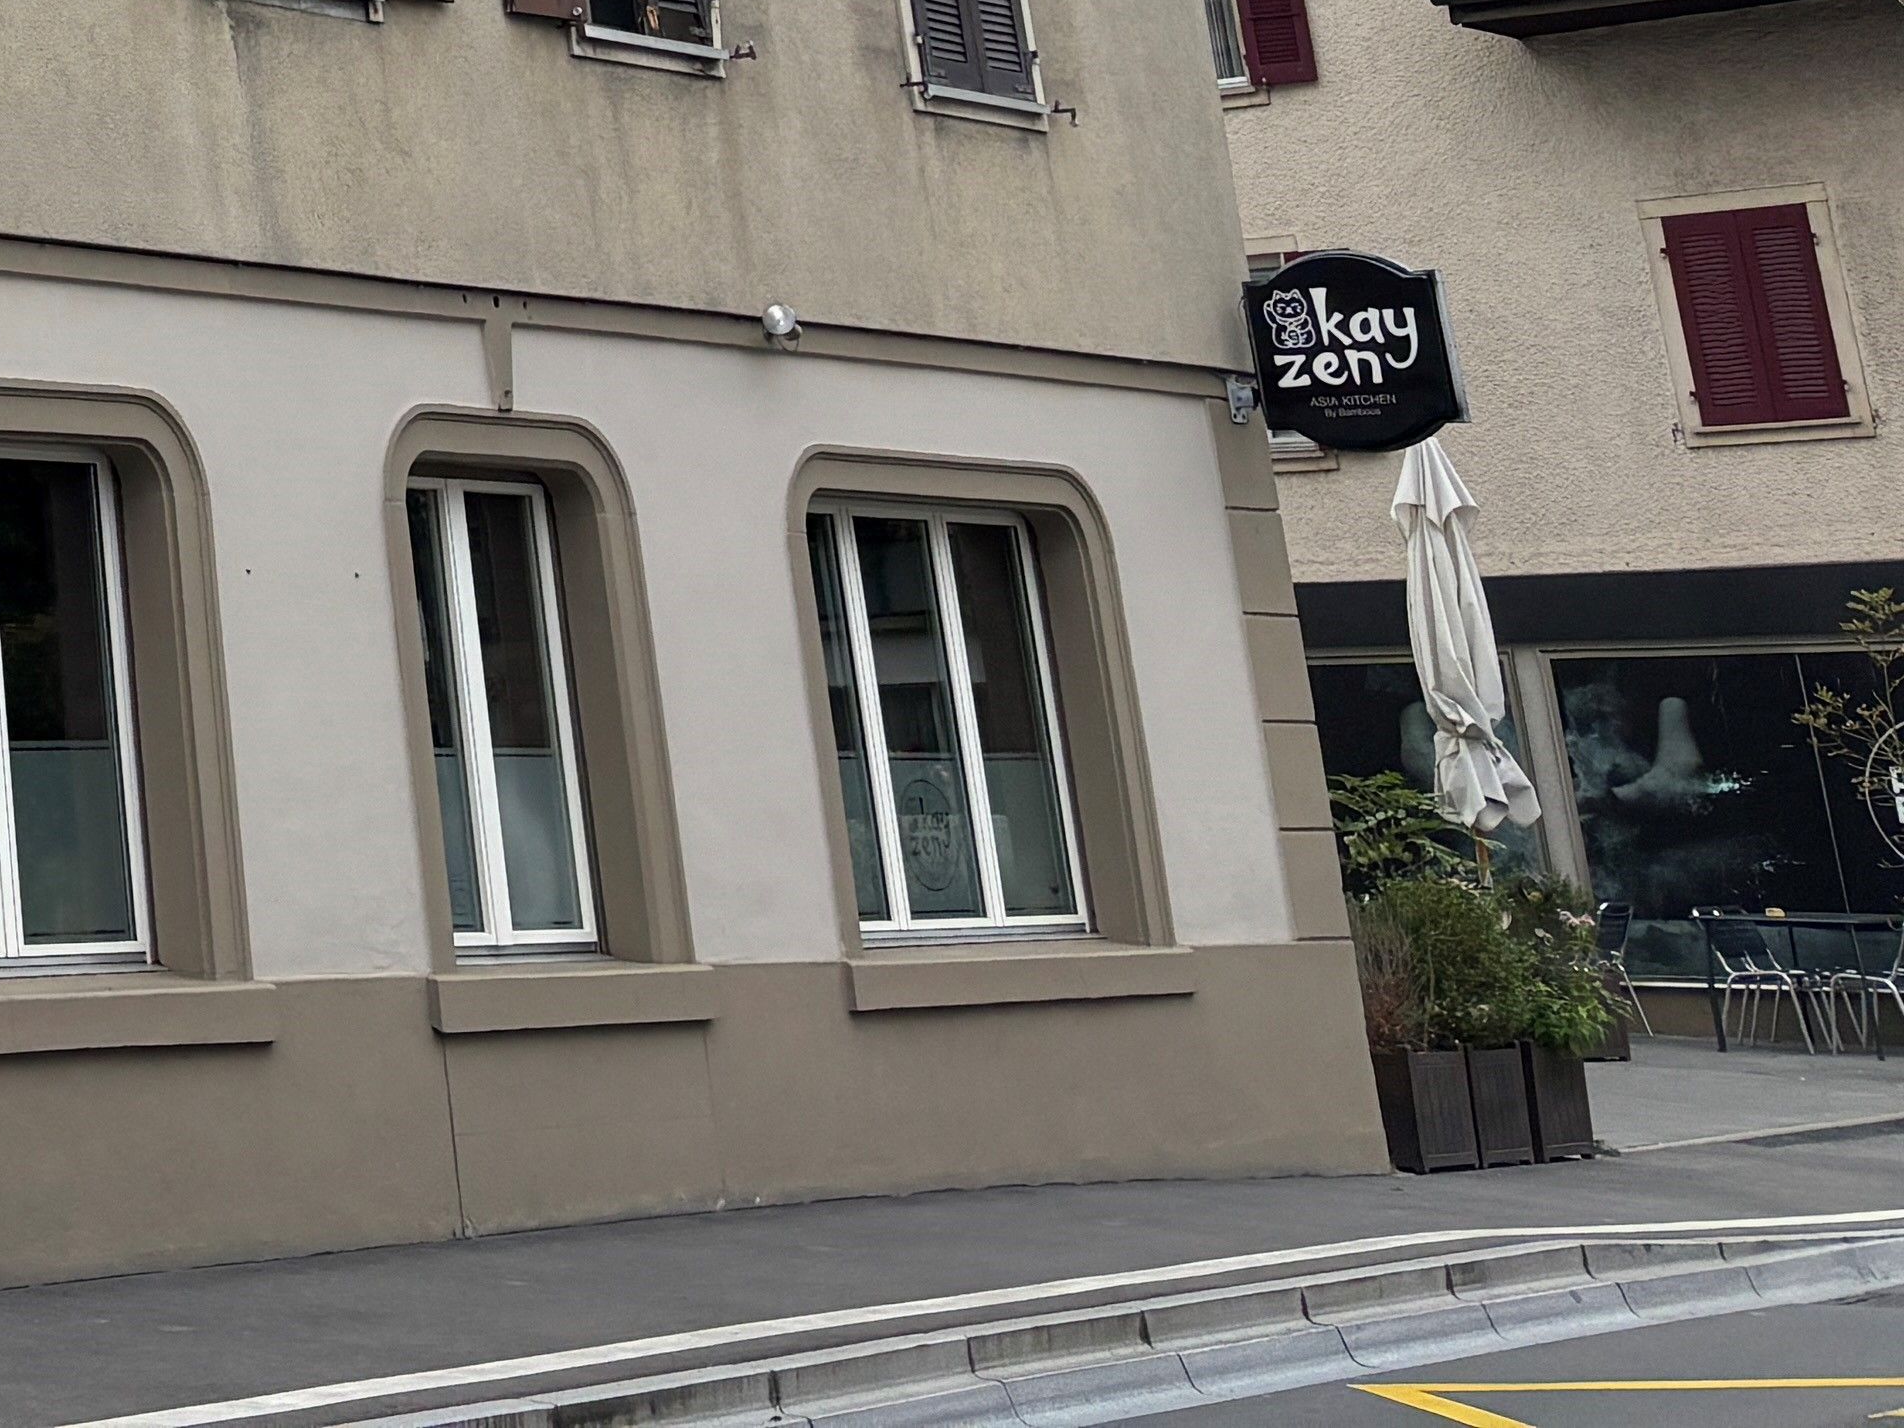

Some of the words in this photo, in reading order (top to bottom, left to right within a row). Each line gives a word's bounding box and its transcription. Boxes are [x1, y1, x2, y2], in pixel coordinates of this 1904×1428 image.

[1309, 287, 1419, 370] kay
[1274, 349, 1383, 388] zen
[1310, 396, 1339, 407] ASIA
[1342, 394, 1397, 406] KITCHEN
